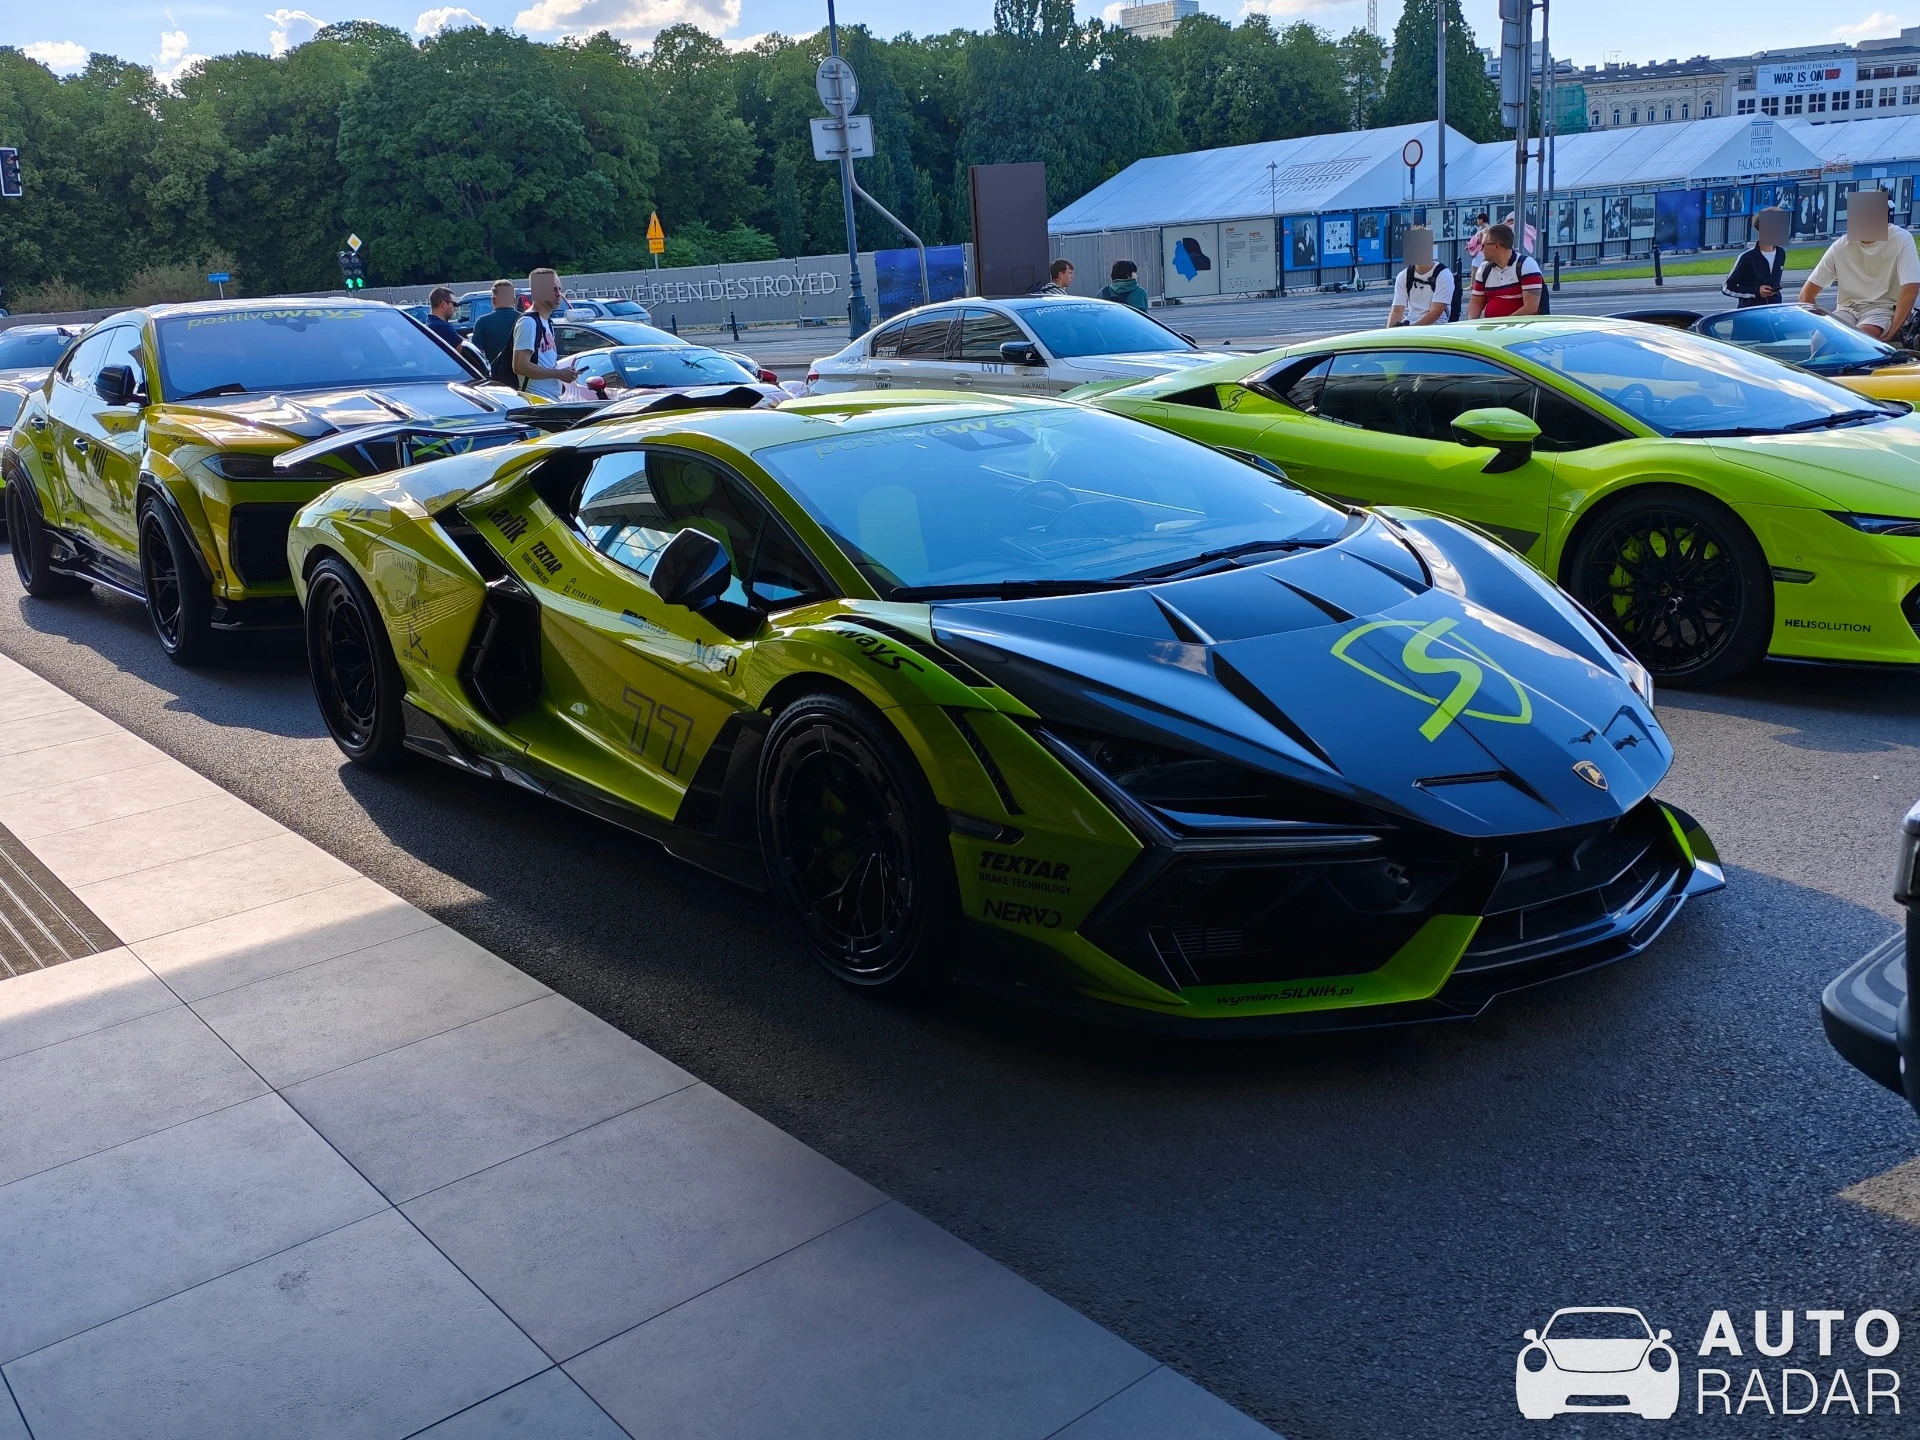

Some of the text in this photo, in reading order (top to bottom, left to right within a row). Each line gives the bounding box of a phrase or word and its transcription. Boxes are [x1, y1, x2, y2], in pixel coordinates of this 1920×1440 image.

[1773, 71, 1793, 85] WAR
[1797, 71, 1806, 83] IS
[1810, 69, 1824, 82] ON
[652, 280, 704, 304] BEEN
[708, 271, 837, 301] DESTROYED
[187, 309, 377, 331] positiveways
[391, 554, 431, 583] SAUVAGE
[530, 541, 563, 576] TEXTAR
[1785, 618, 1871, 633] HELISOLUTION
[622, 685, 695, 777] 77
[980, 850, 1071, 881] TEXTAR
[979, 871, 1072, 896] BRAKE TECHNOLOGY
[1216, 985, 1355, 1007] wymienSILNIK.pl
